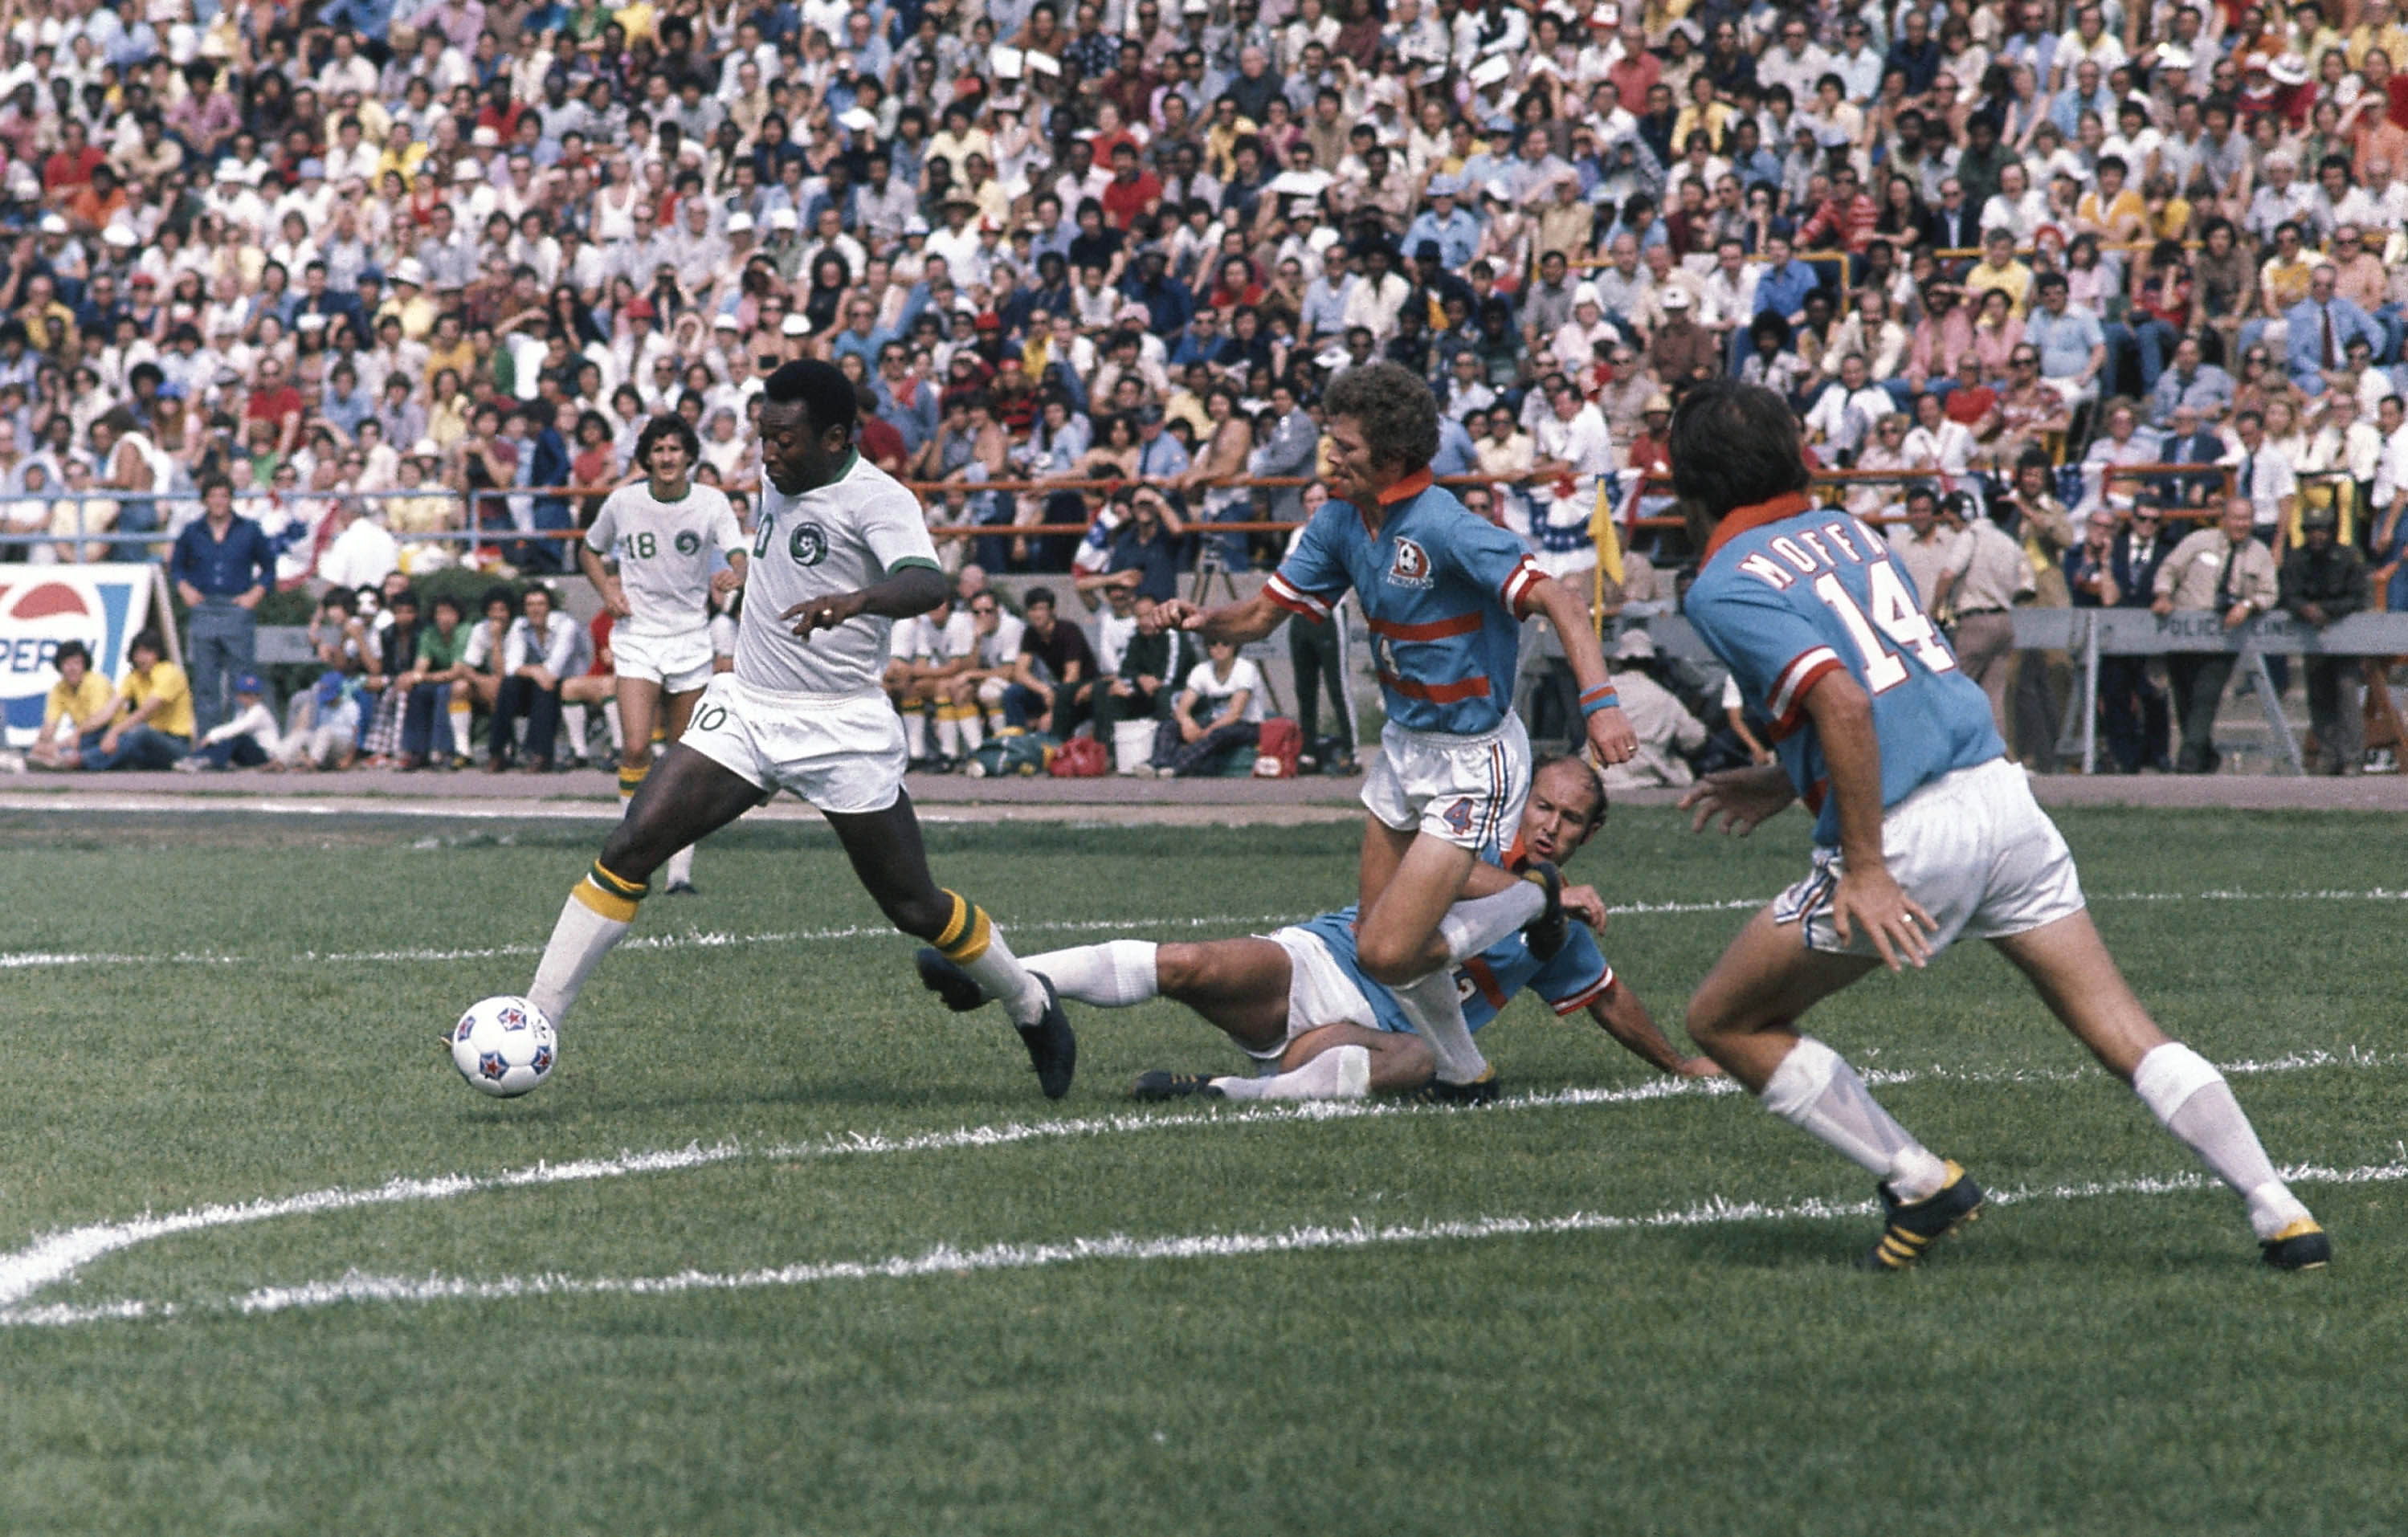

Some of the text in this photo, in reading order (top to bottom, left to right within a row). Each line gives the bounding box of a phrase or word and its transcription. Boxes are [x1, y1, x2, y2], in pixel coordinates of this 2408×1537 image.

[626, 532, 656, 559] 18
[1814, 559, 1957, 695] 14
[688, 702, 727, 732] 10
[1443, 797, 1474, 836] 4
